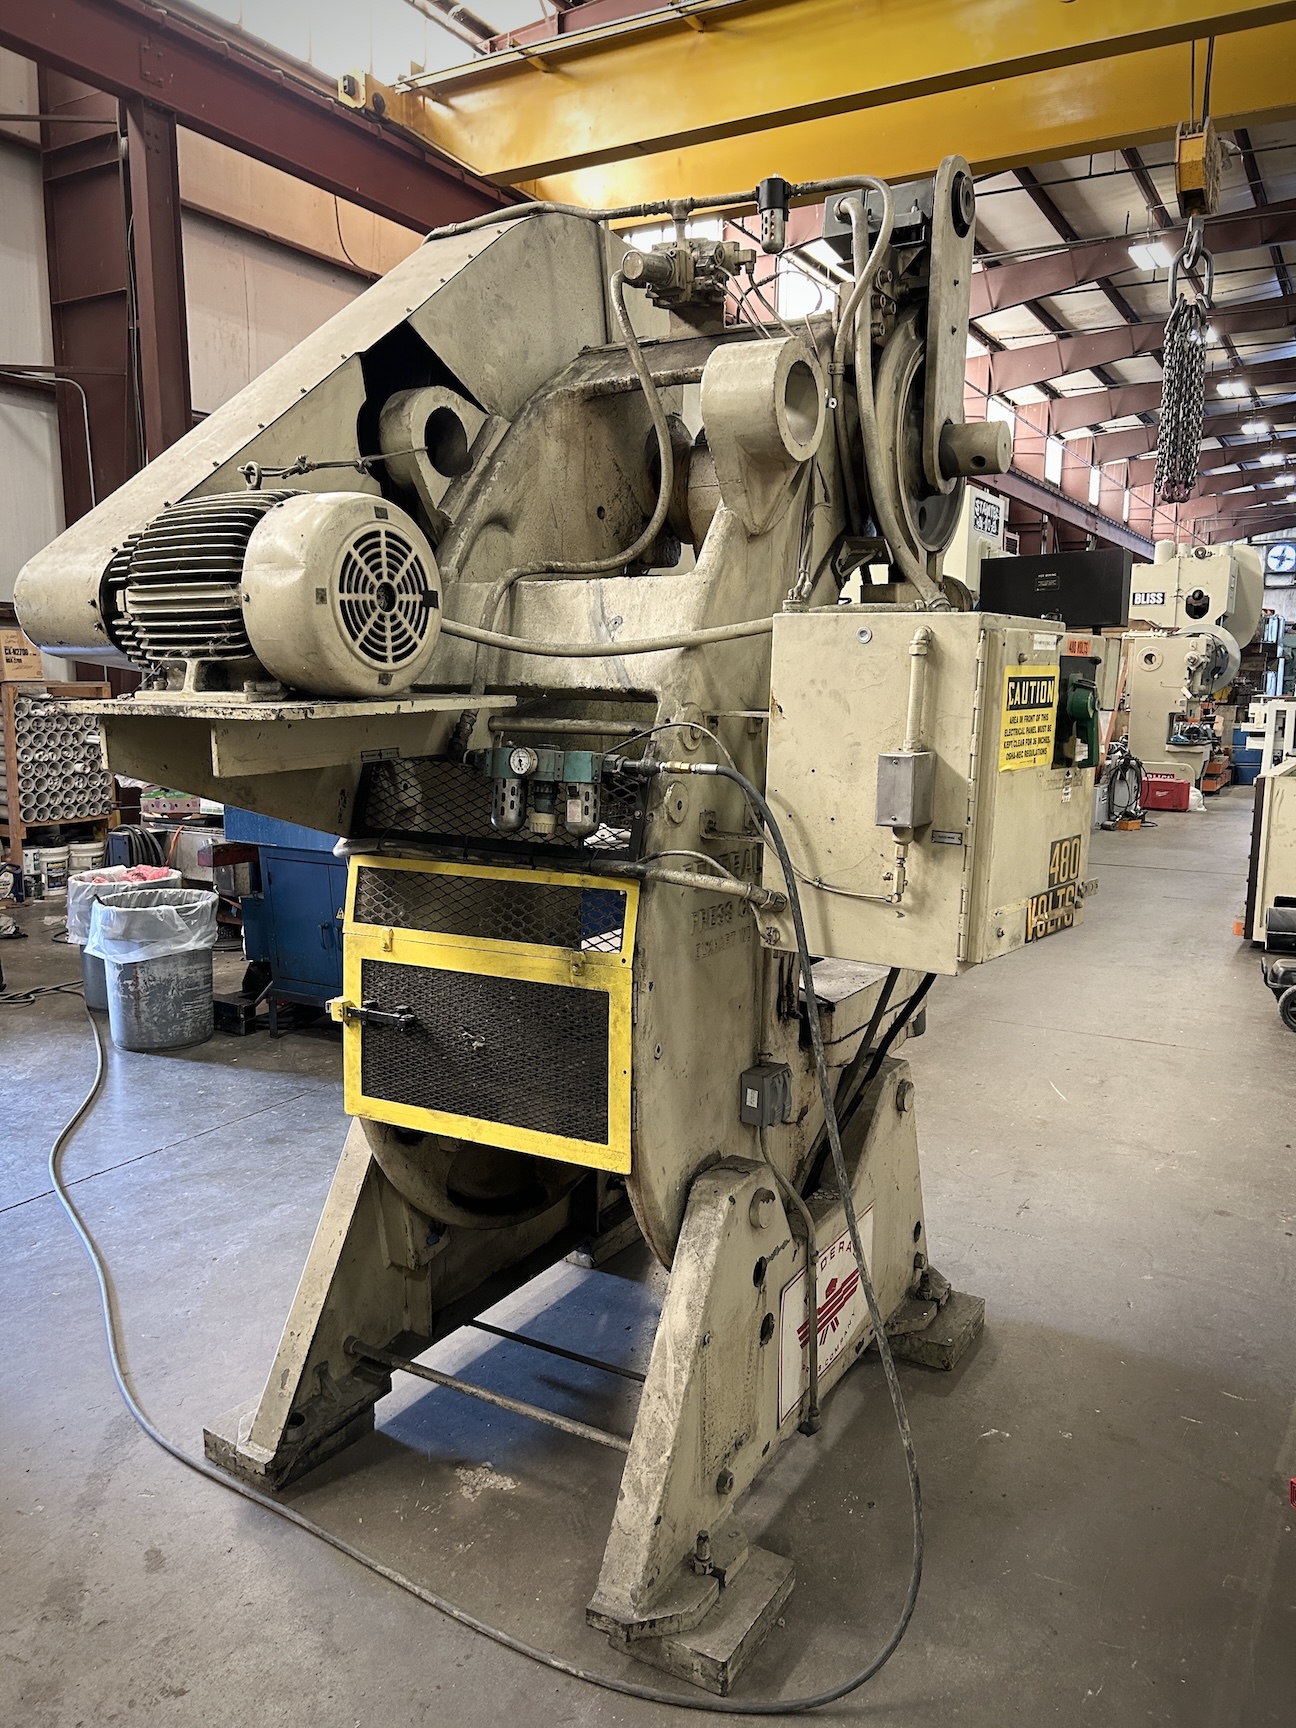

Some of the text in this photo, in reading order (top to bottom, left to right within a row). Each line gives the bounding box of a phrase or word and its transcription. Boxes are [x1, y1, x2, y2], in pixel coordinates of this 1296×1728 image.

[1134, 592, 1163, 605] BLISS
[1008, 680, 1055, 706] CAUTION
[1009, 715, 1019, 724] AREA
[1024, 714, 1036, 723] FRONT
[1041, 713, 1049, 721] THIS
[1004, 724, 1052, 737] ELECTRICAL PANEL MUST BE
[1003, 740, 1013, 749] KEPT
[1013, 738, 1025, 748] CLEAR
[1024, 747, 1048, 758] REGULATIONS
[1049, 838, 1081, 885] 480
[1026, 885, 1075, 941] VOLTS
